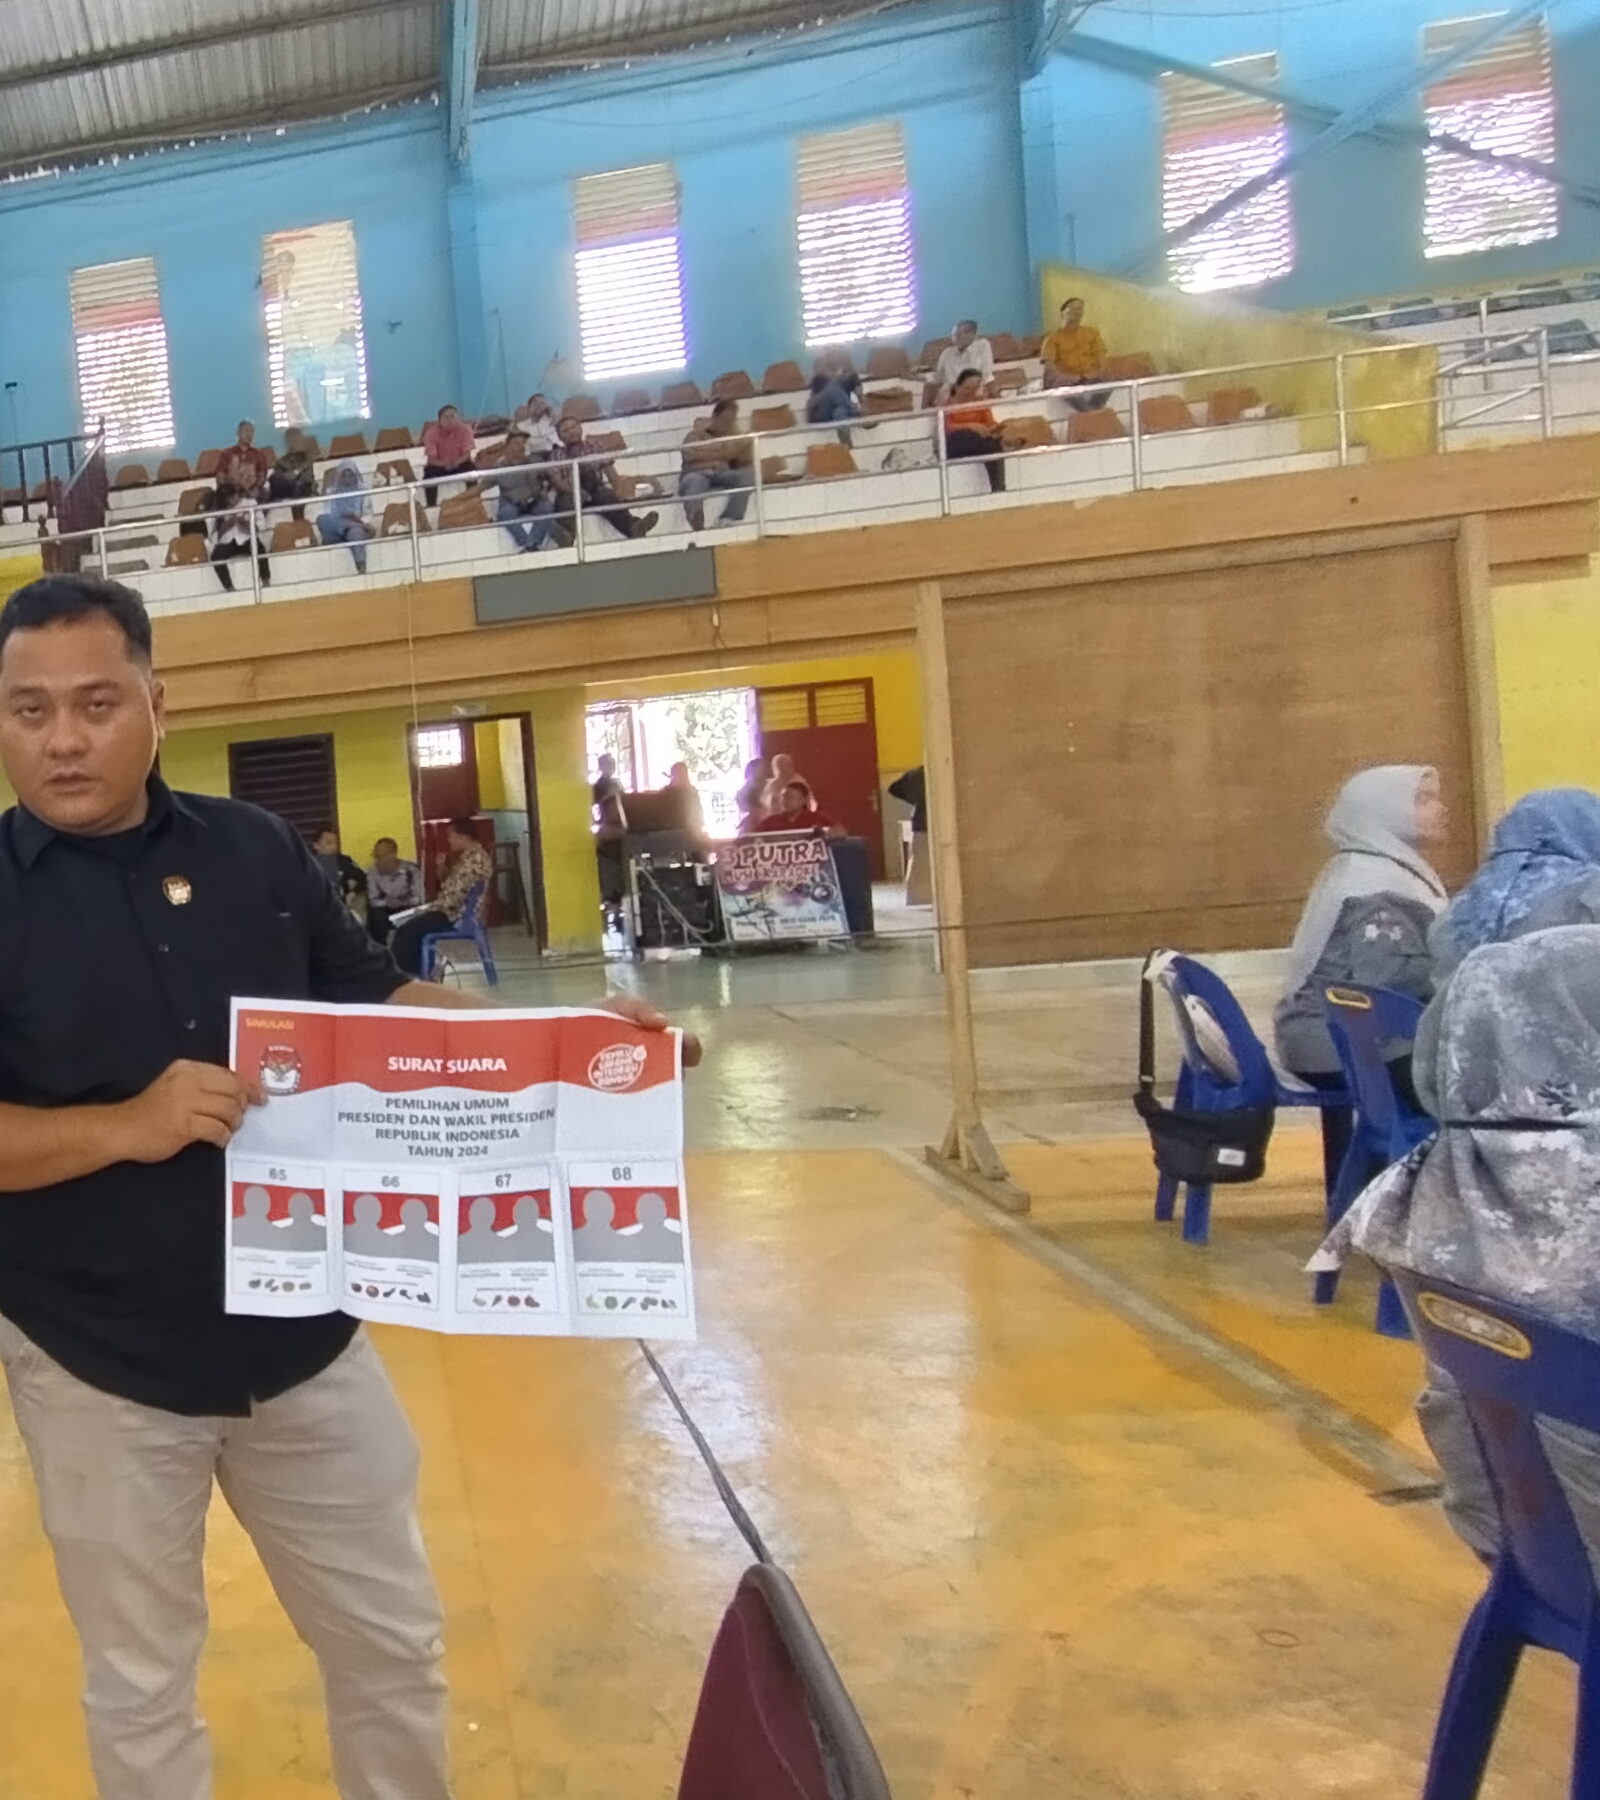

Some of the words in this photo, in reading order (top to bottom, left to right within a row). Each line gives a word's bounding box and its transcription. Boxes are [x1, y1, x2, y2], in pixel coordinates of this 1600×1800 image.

[739, 839, 828, 867] PUTRA
[245, 1018, 295, 1030] SIMULASI
[387, 1056, 443, 1072] SURAT
[446, 1058, 507, 1074] SUARA
[385, 1098, 460, 1111] PEMILIHAN
[464, 1098, 509, 1109] UMUM
[338, 1112, 405, 1125] PRESIDEN
[409, 1114, 440, 1126] DAN
[444, 1114, 486, 1127] WAKIL
[491, 1108, 555, 1124] PRESIDEN
[375, 1128, 441, 1142] REPUBLIK
[446, 1128, 520, 1142] INDONESIA
[407, 1145, 453, 1158] TAHUN
[457, 1145, 489, 1157] 2024
[269, 1167, 288, 1181] 65
[495, 1173, 512, 1188] 67
[612, 1166, 632, 1181] 68
[381, 1175, 400, 1188] 66
